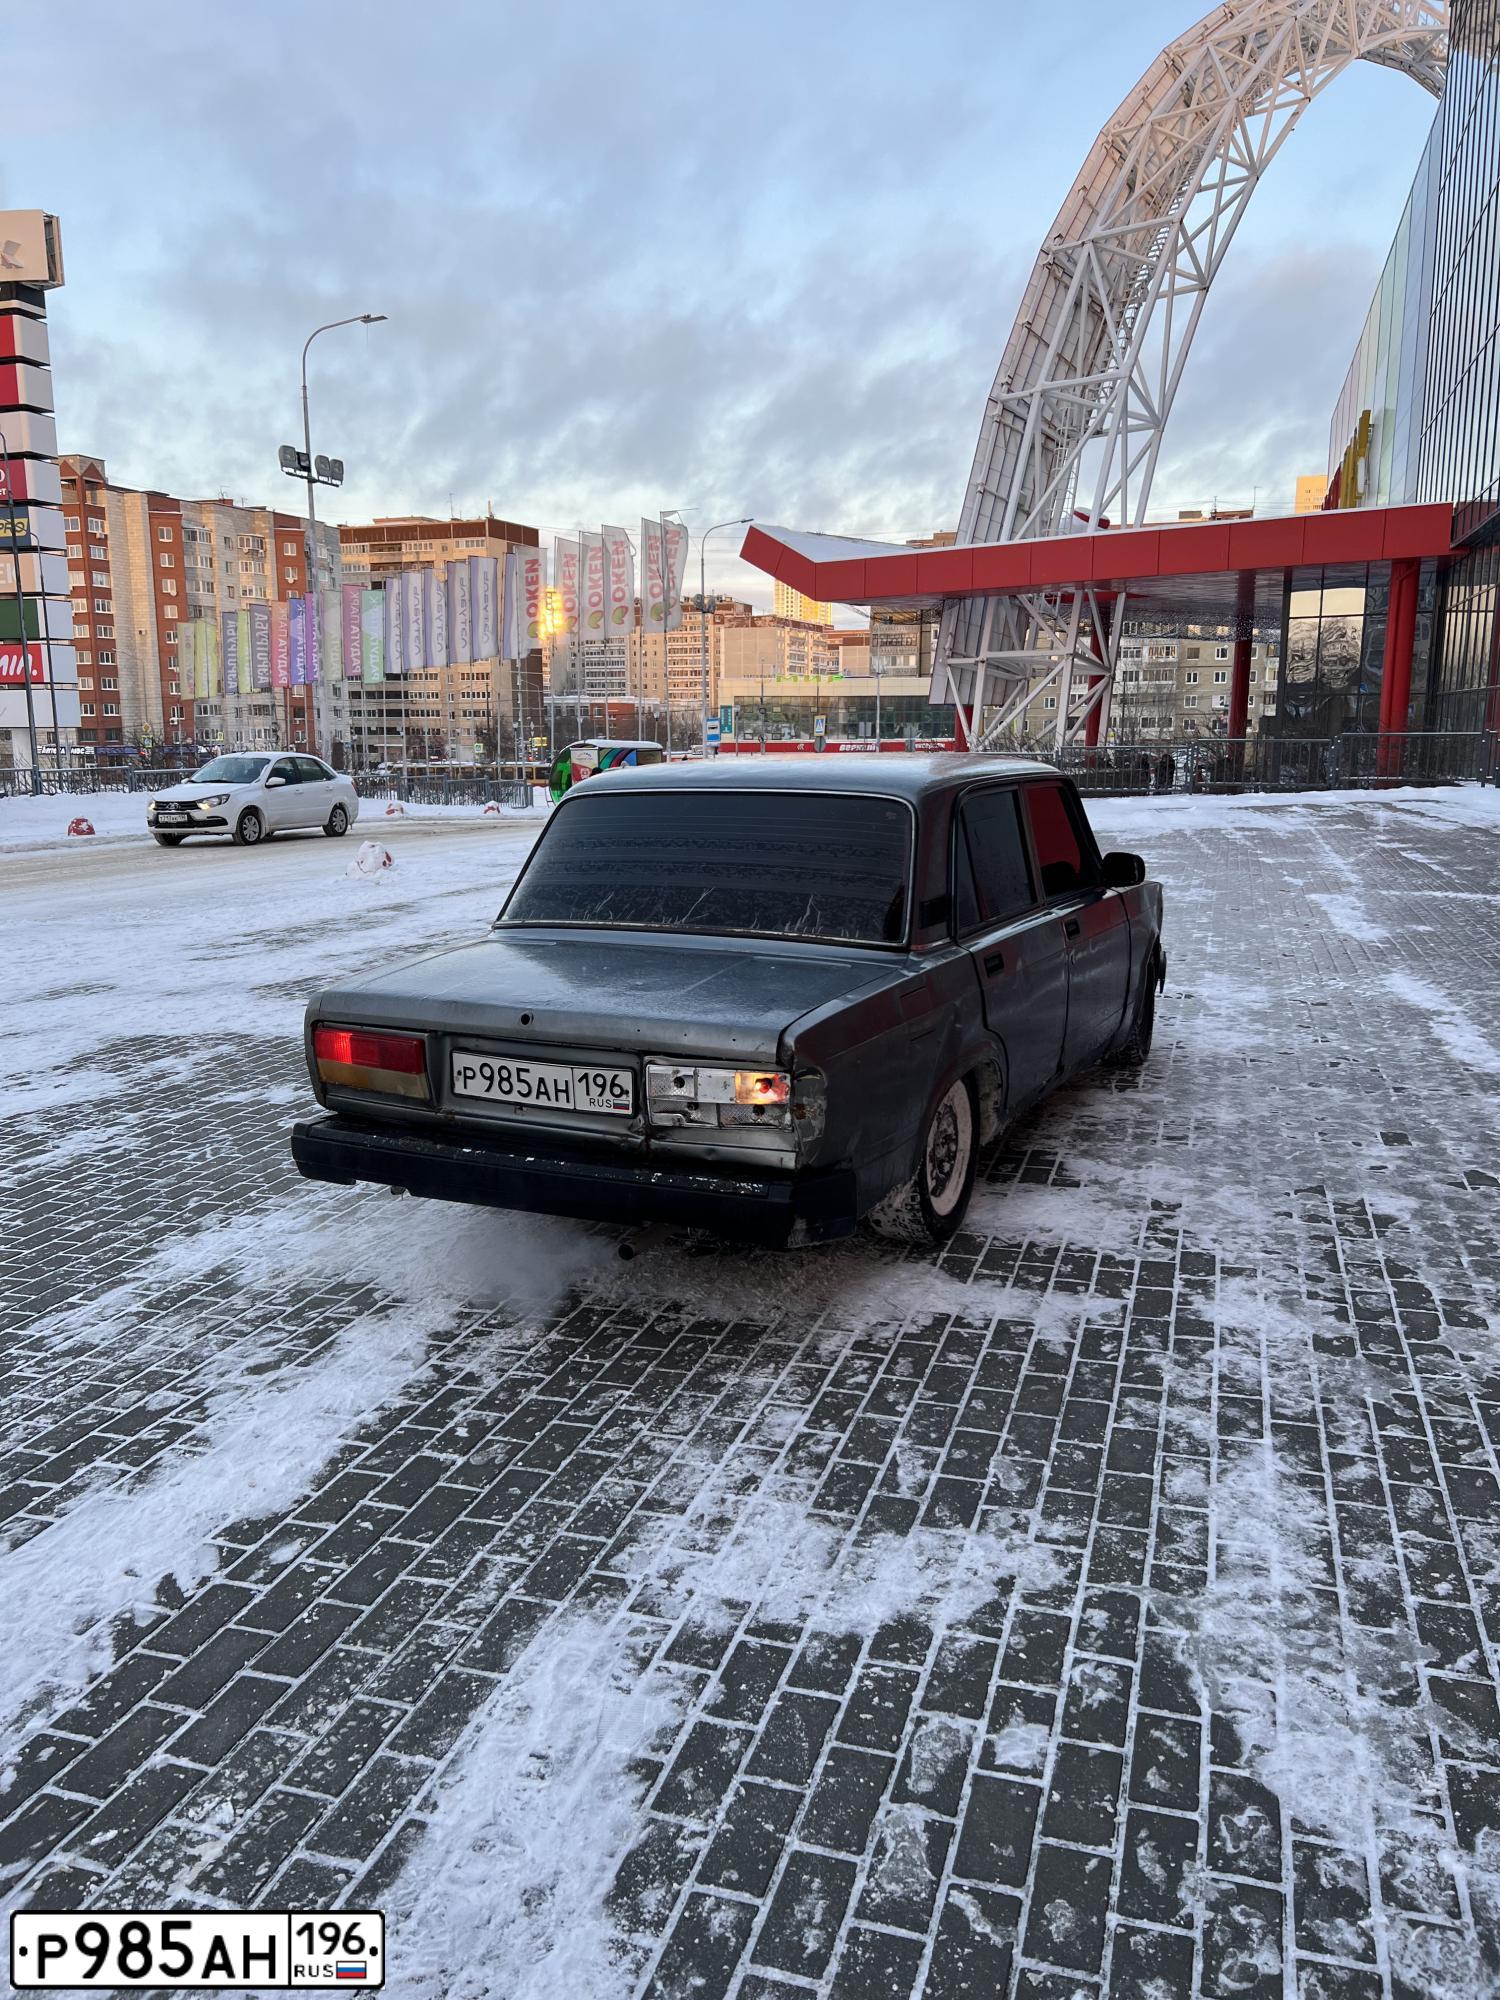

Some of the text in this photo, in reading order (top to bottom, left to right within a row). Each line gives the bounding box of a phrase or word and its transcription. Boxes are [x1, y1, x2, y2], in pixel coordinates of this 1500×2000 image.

[462, 1062, 624, 1104] Р985АН 196
[589, 1097, 612, 1109] RUS
